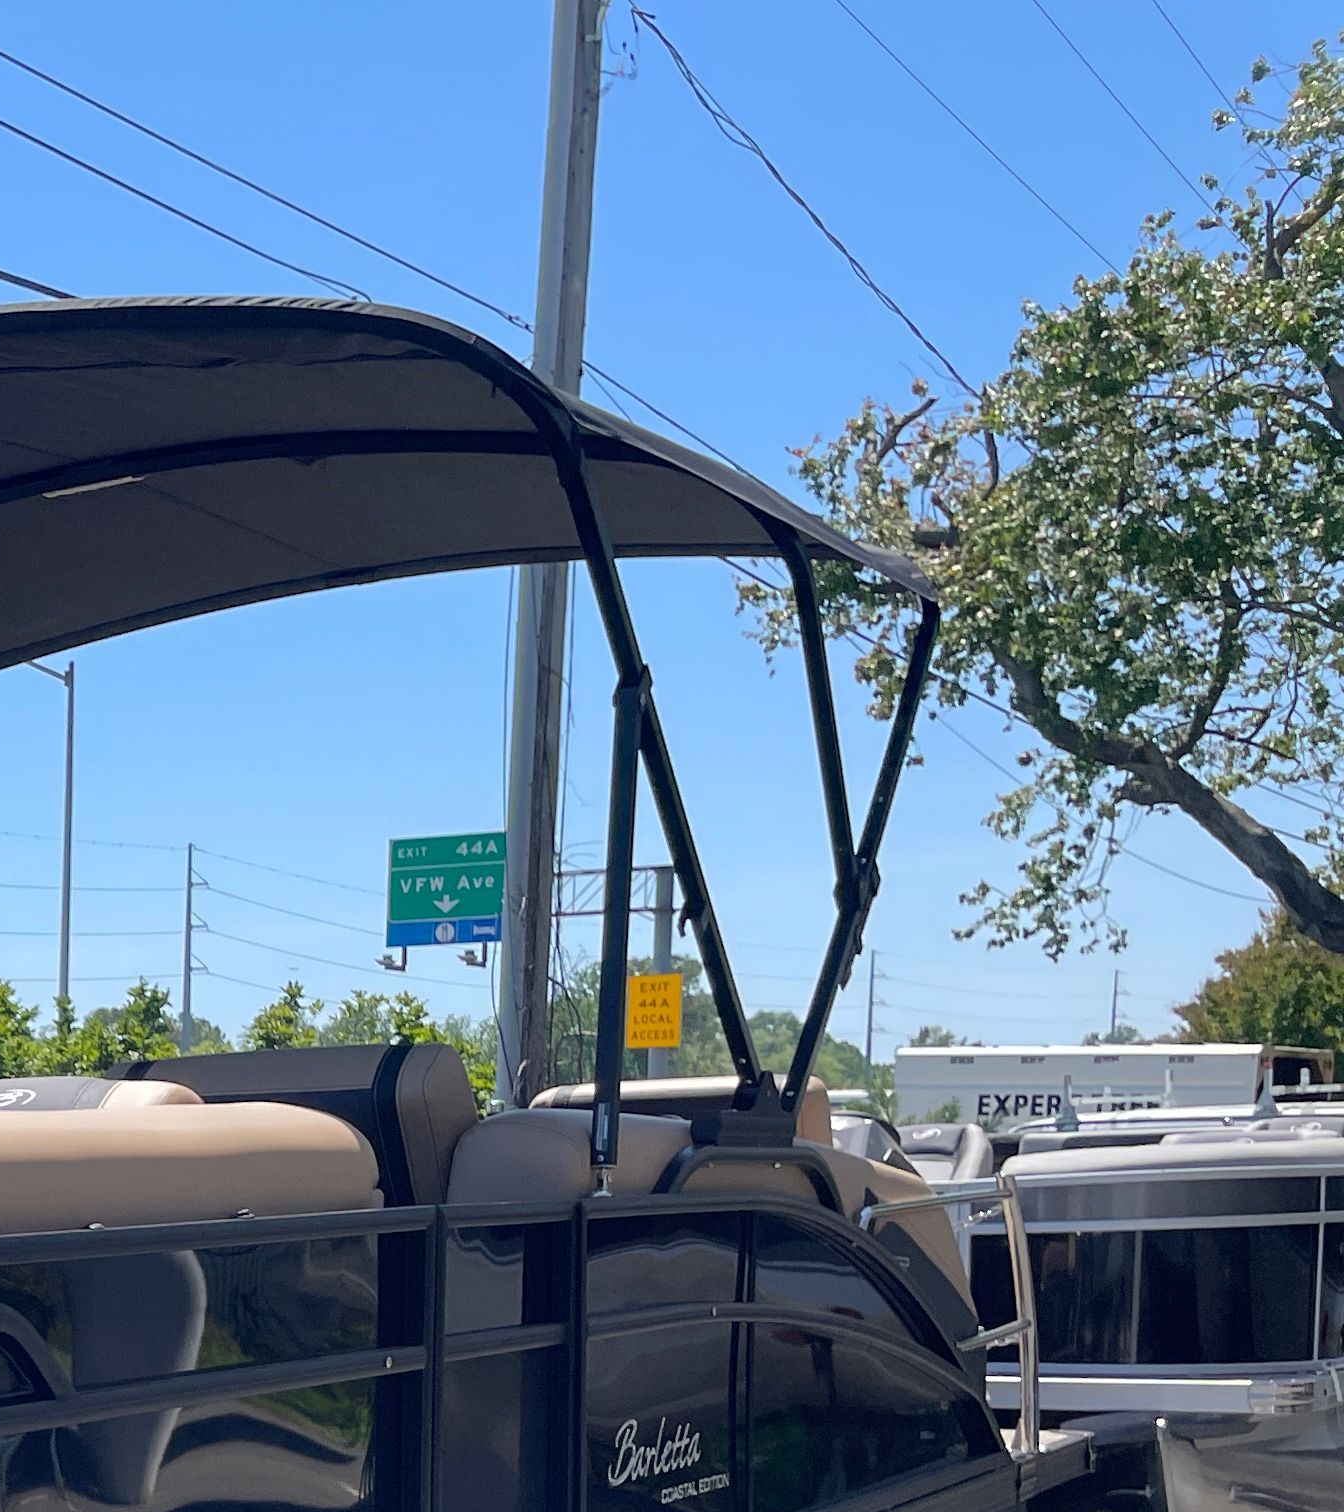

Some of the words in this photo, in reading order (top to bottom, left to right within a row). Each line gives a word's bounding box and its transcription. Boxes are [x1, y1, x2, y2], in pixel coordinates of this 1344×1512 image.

[397, 846, 428, 859] EXIT
[455, 839, 498, 856] 44A
[400, 876, 445, 893] VFW
[456, 875, 495, 890] Ave
[639, 981, 669, 993] EXIT
[633, 1013, 673, 1025] LOCAL
[631, 1029, 675, 1041] ACCESS
[608, 1416, 701, 1487] Barletta
[661, 1480, 698, 1504] COASTAL
[698, 1472, 730, 1494] EDITION
